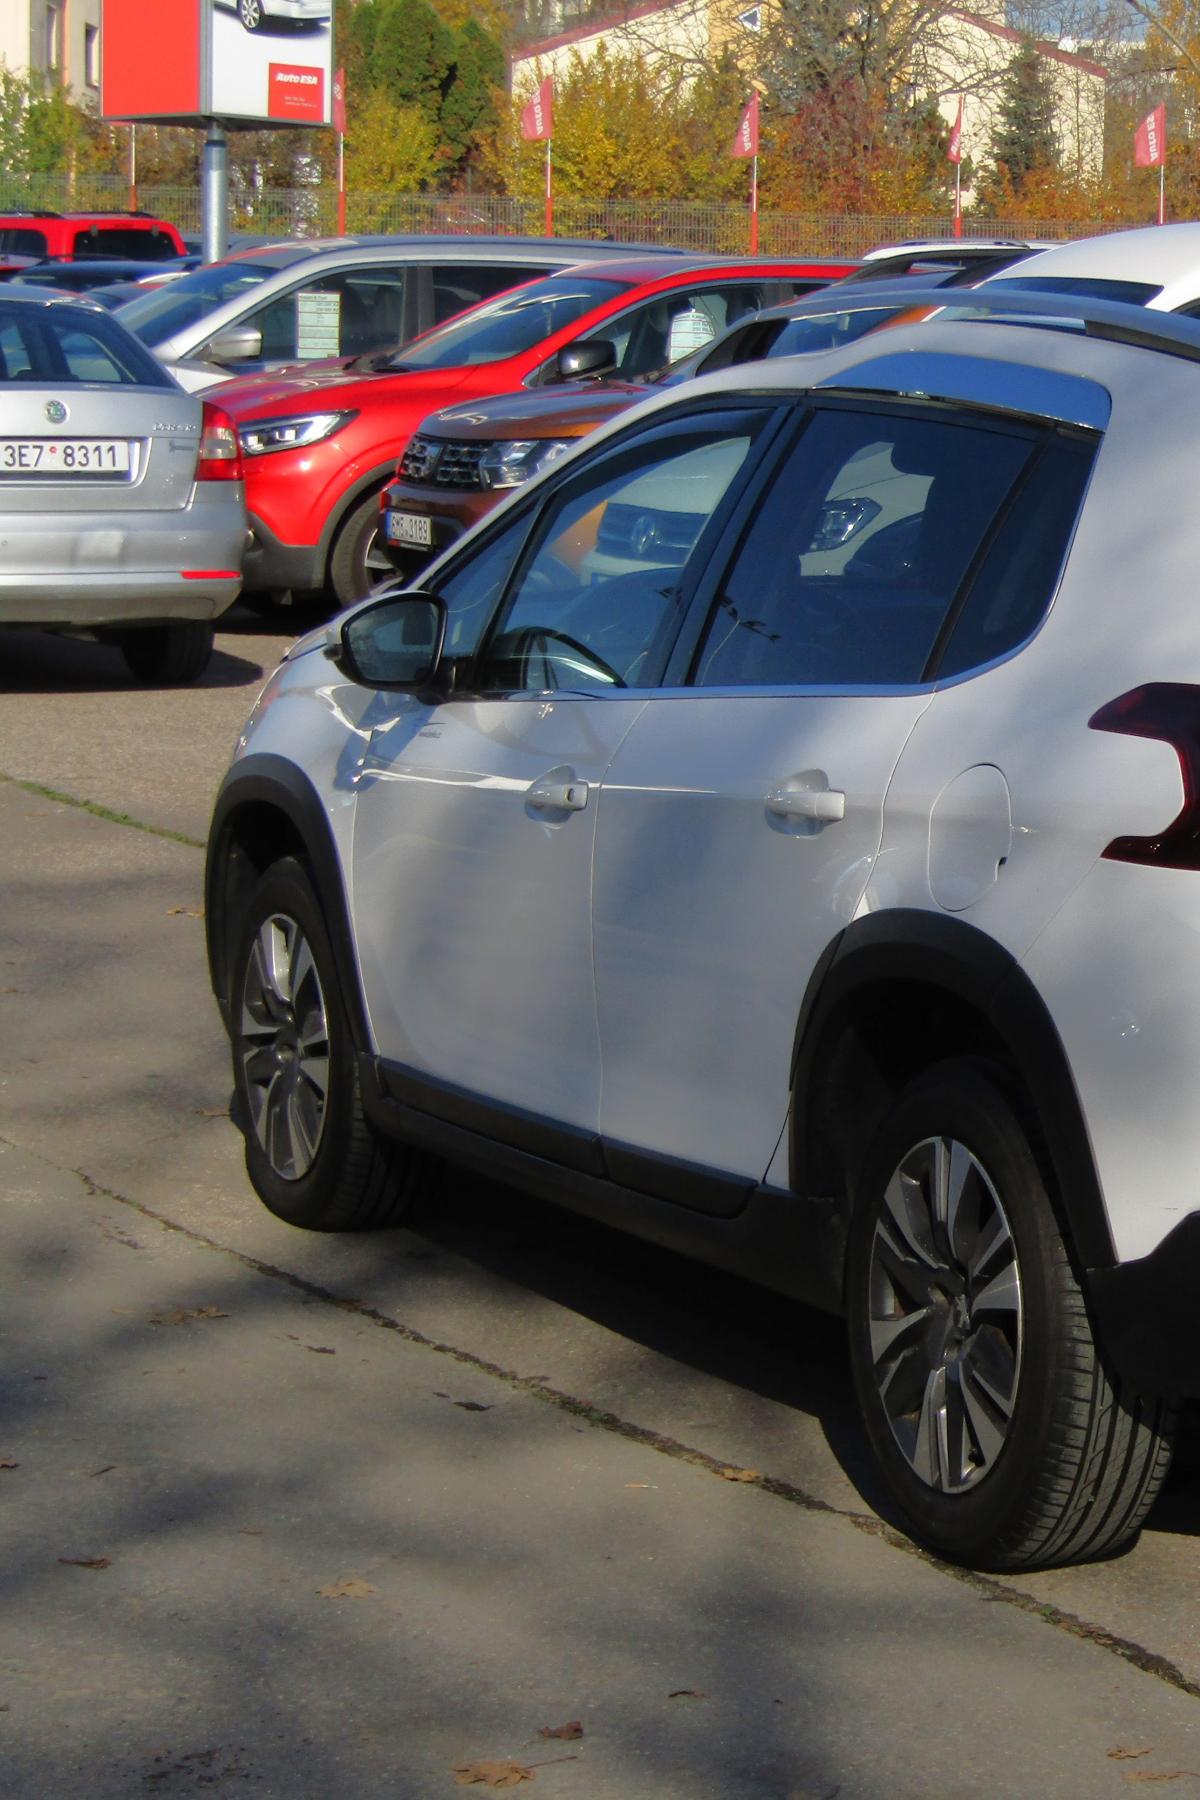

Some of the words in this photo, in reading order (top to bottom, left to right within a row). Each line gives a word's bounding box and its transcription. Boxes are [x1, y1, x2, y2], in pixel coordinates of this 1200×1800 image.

[276, 72, 300, 83] Auto
[300, 76, 319, 86] ESA
[1148, 131, 1158, 163] Auto
[4, 445, 44, 468] 3E7
[63, 445, 118, 468] 8311
